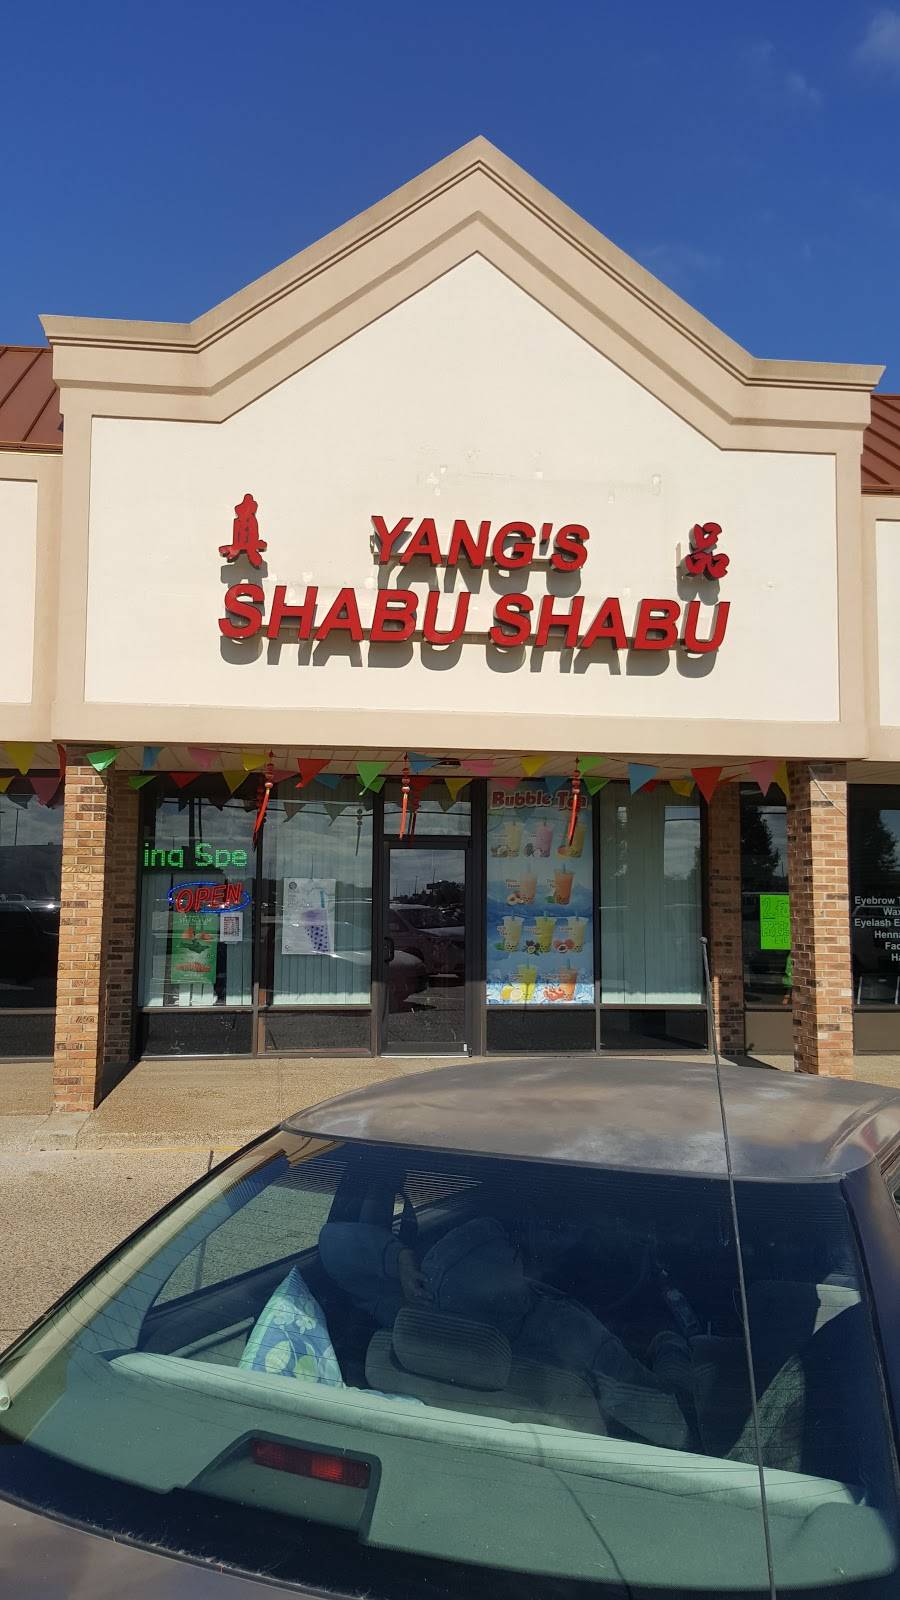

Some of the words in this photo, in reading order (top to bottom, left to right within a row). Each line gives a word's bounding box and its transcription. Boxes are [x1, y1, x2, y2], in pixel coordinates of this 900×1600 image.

[371, 515, 590, 573] YANG'S
[217, 582, 472, 647] SHABU
[488, 592, 731, 654] SHABU
[491, 790, 552, 810] Bubble
[176, 882, 244, 913] OPEN
[854, 896, 895, 907] Eyebrow
[854, 918, 891, 928] Eyelash
[874, 930, 900, 939] Henn
